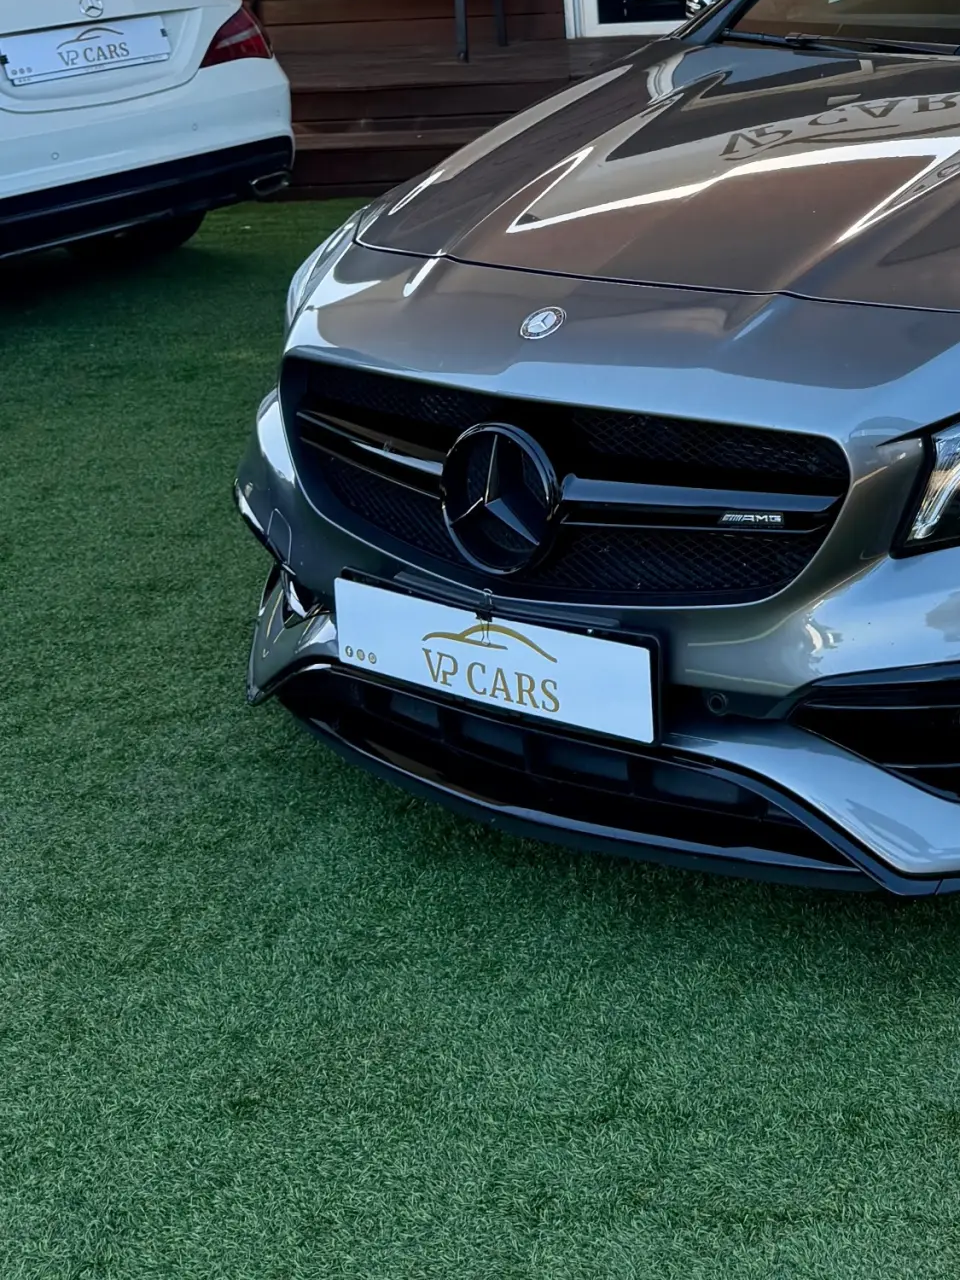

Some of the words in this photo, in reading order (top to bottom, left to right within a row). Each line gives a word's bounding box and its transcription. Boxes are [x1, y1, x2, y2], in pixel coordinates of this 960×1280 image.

[57, 49, 79, 66] VP
[83, 42, 130, 63] CARS
[422, 647, 459, 687] VP
[466, 661, 561, 713] CARS
